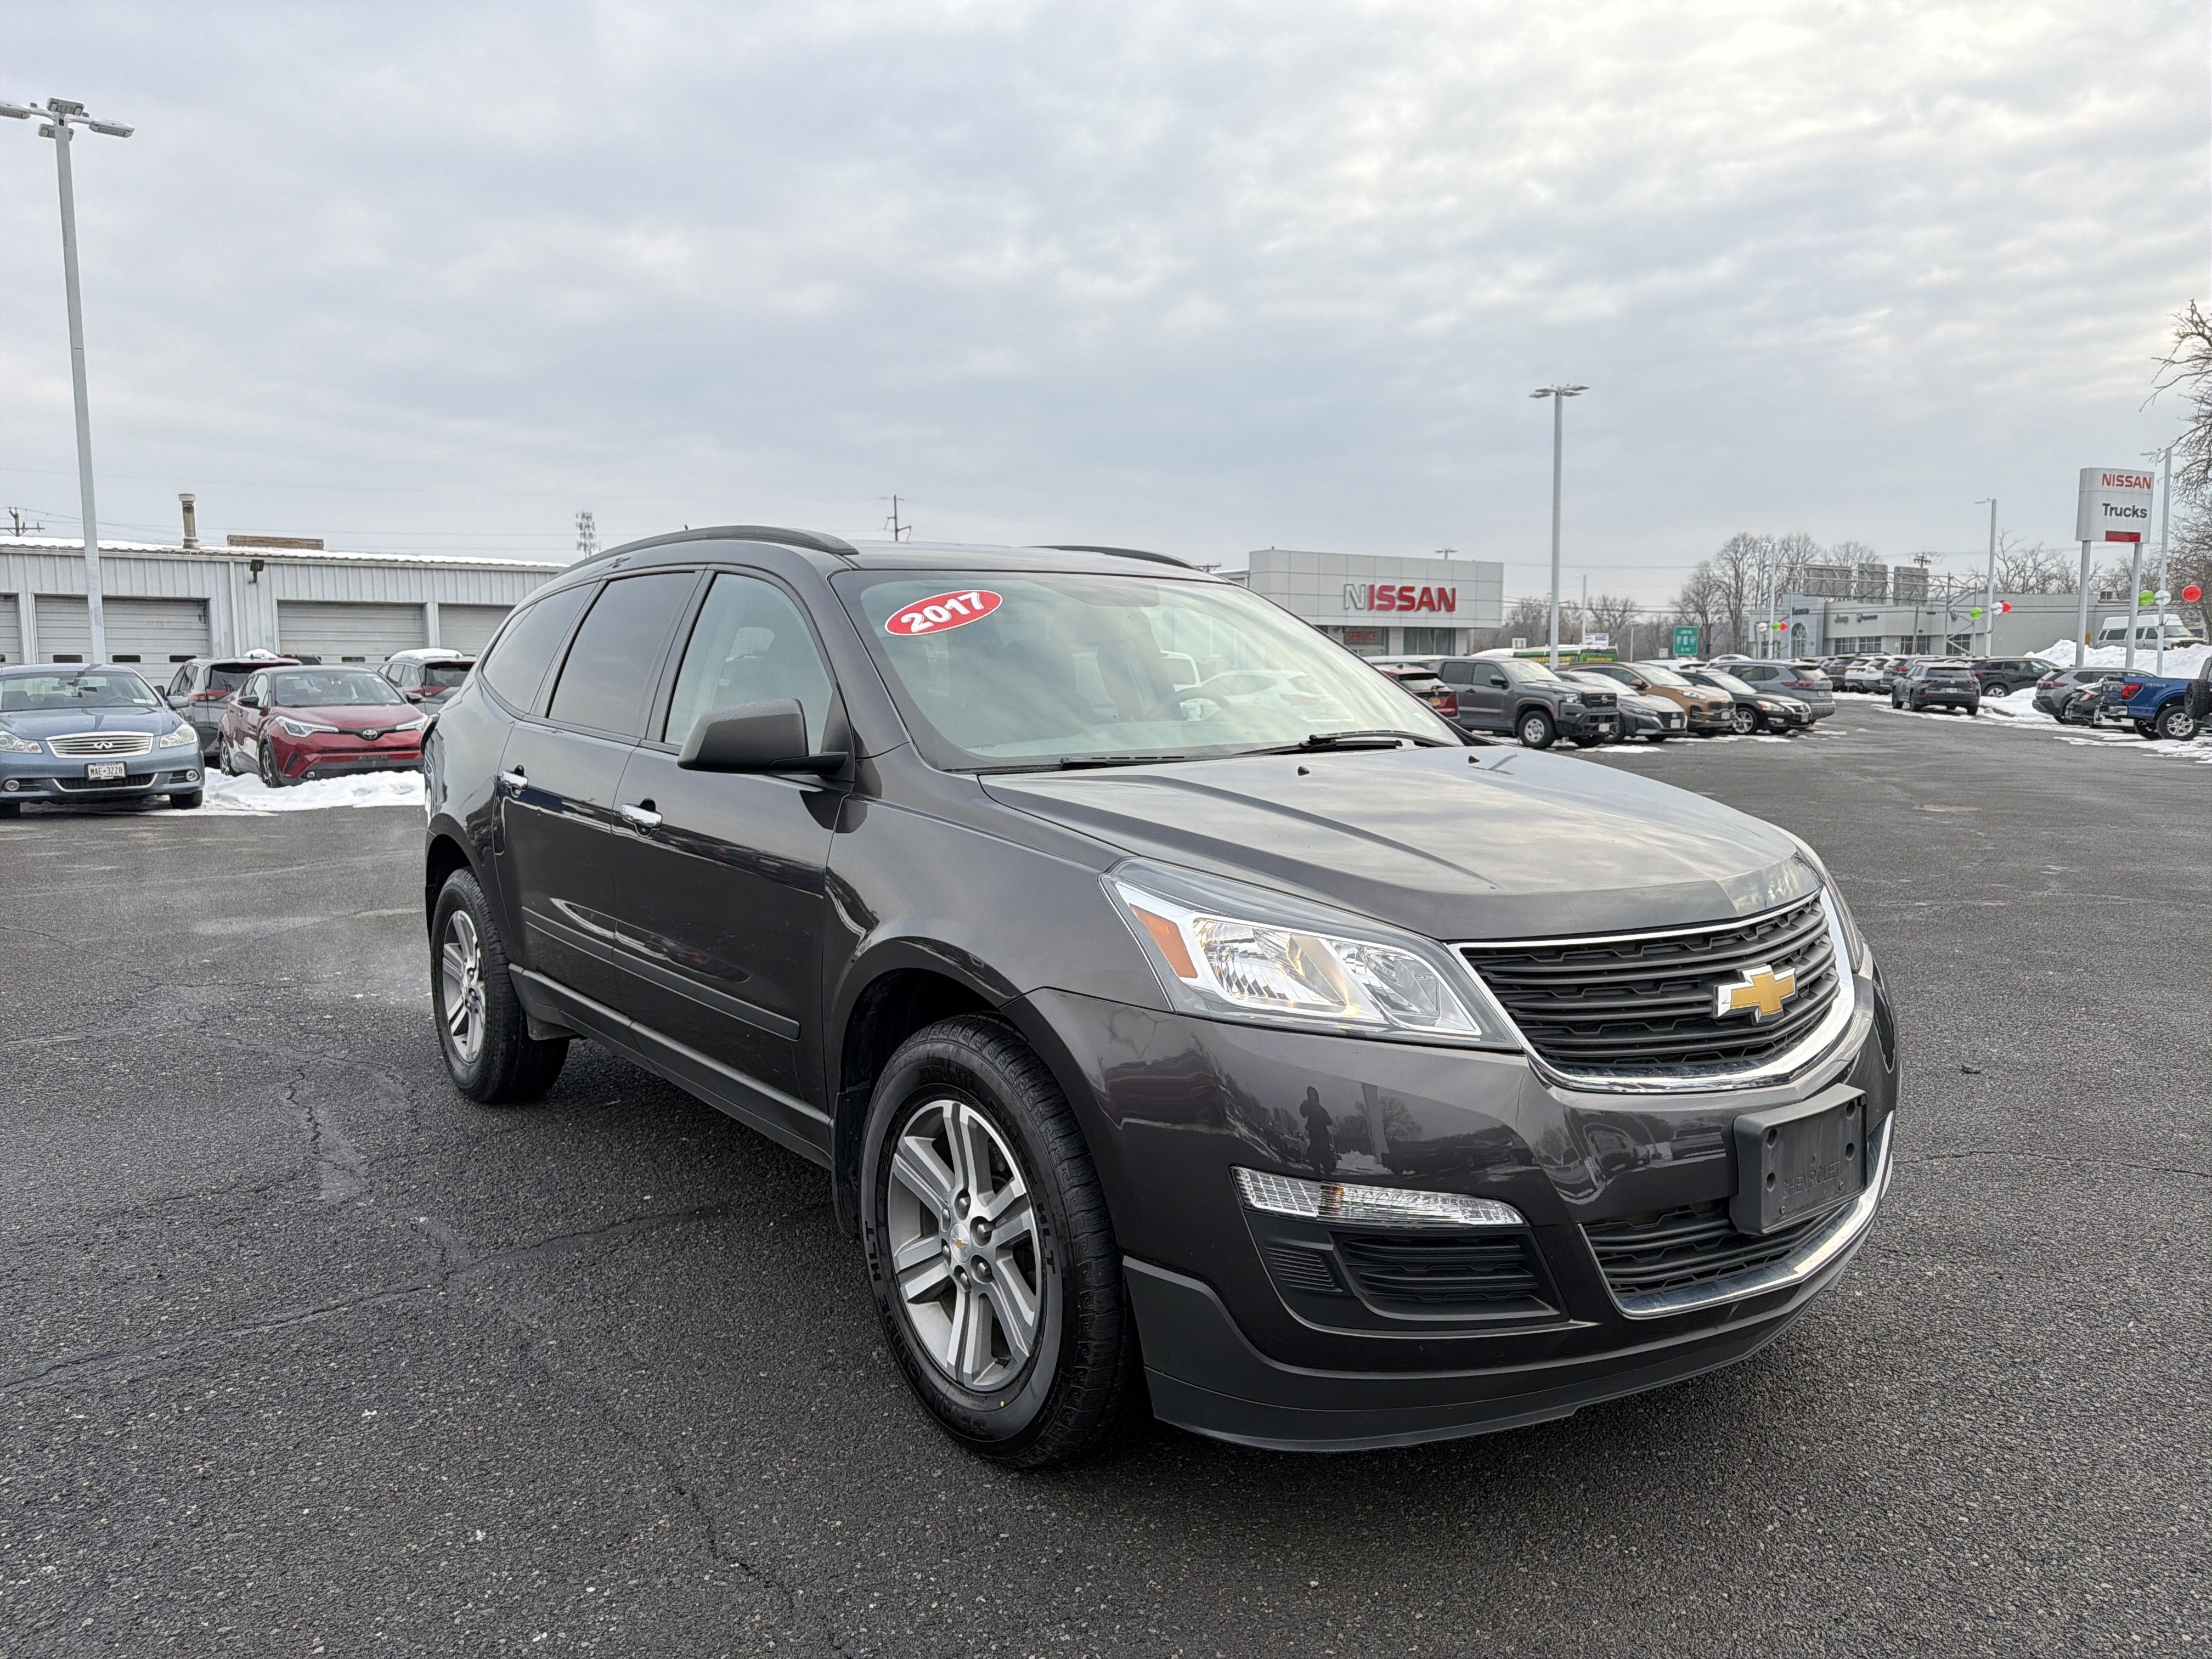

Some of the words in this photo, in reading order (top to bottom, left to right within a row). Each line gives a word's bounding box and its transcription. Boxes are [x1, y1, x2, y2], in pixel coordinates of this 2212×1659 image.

[2102, 473, 2152, 489] NISSAN
[2102, 503, 2148, 518] Trucks
[1344, 583, 1456, 612] NISSAN
[900, 591, 984, 633] 2017
[1347, 631, 1378, 642] SERVICE
[1781, 1160, 1840, 1200] CHEVROLET
